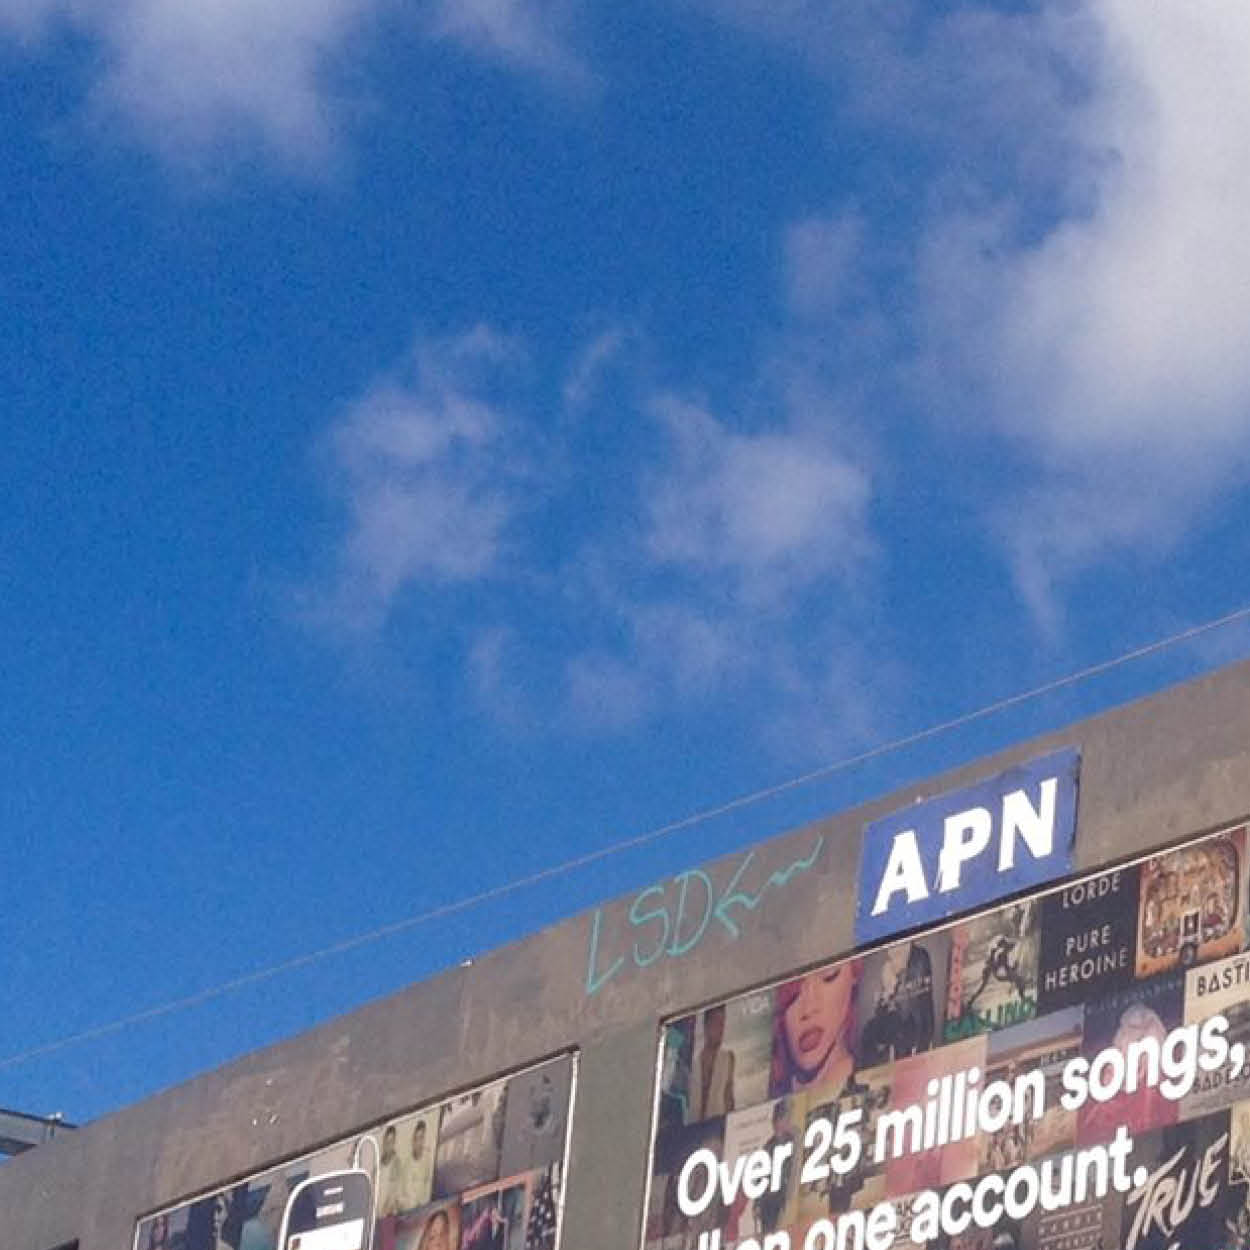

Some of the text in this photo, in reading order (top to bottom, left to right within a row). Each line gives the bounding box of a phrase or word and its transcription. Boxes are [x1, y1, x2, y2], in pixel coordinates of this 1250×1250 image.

[870, 777, 1058, 917] APN
[1062, 871, 1121, 910] LORDE
[1044, 945, 1129, 991] HEROINE
[1066, 924, 1112, 957] PURE
[677, 1142, 793, 1216] Over
[800, 1109, 862, 1184] 25
[873, 1067, 1045, 1163] million
[1060, 1015, 1247, 1111] songs,
[910, 1125, 1149, 1243] account.
